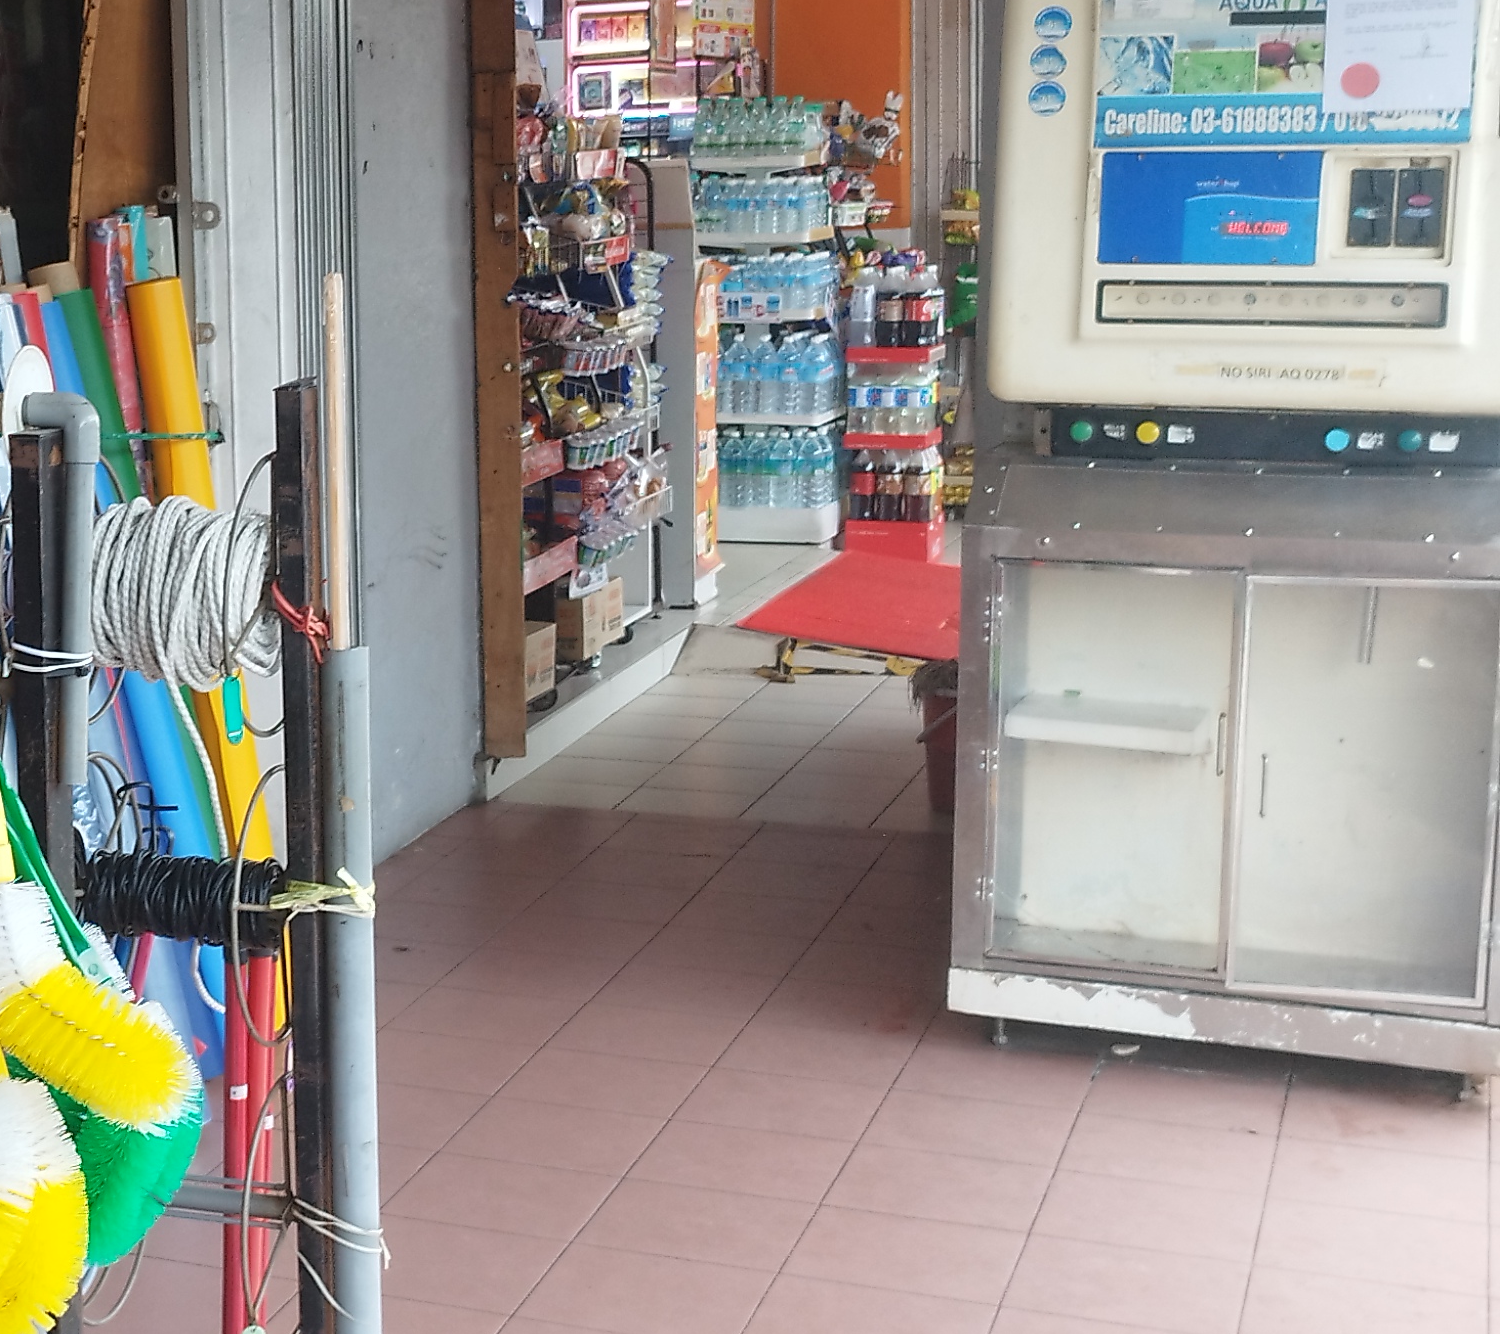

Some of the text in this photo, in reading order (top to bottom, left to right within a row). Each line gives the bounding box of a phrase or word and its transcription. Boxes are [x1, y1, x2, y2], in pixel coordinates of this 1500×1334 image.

[1104, 108, 1187, 135] Careline:
[1227, 221, 1288, 236] WELCOME
[1220, 367, 1242, 378] NO
[1247, 367, 1271, 378] SIRI
[1304, 368, 1339, 380] 0278
